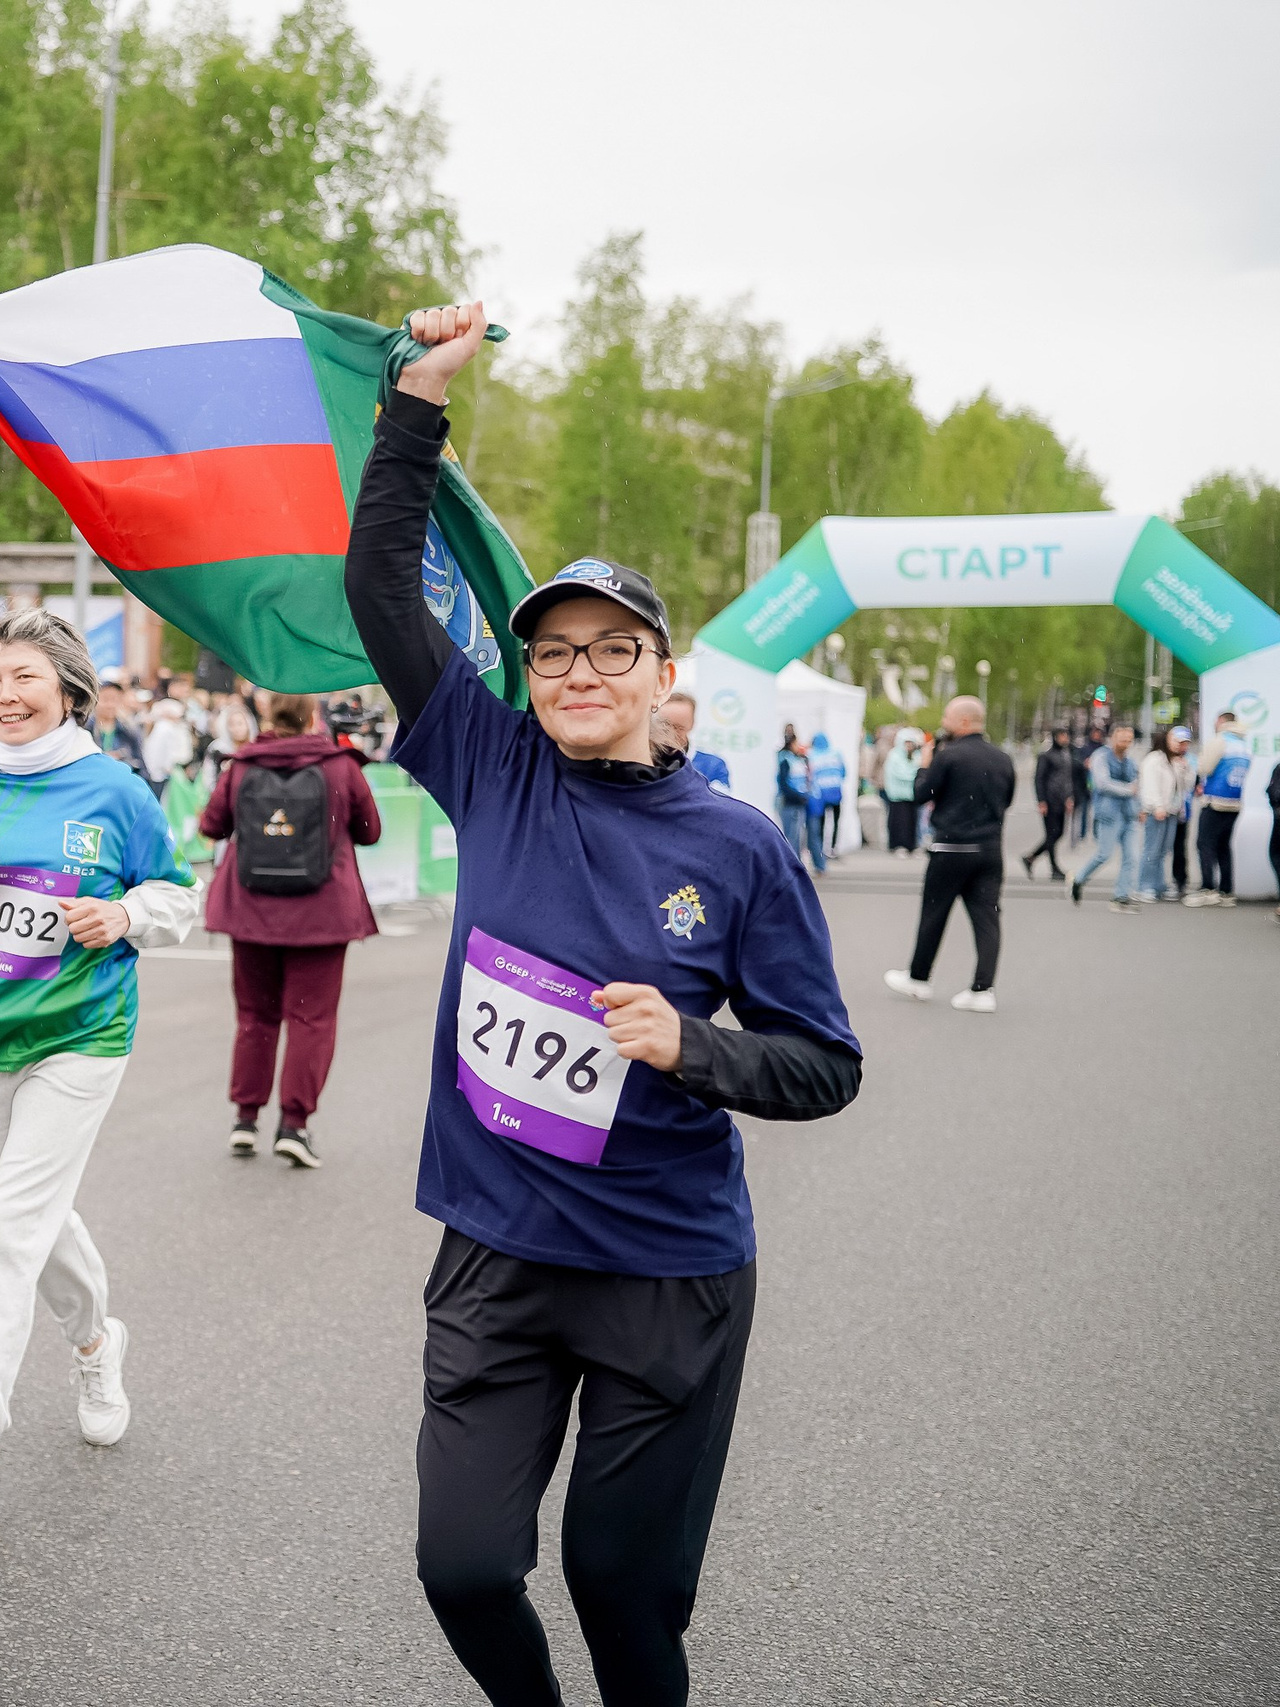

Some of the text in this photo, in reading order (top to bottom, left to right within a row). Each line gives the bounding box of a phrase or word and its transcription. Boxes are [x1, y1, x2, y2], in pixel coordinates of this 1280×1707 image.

[896, 545, 1062, 581] СТАРТ
[505, 962, 529, 978] СБЕР
[472, 1001, 602, 1094] 2196
